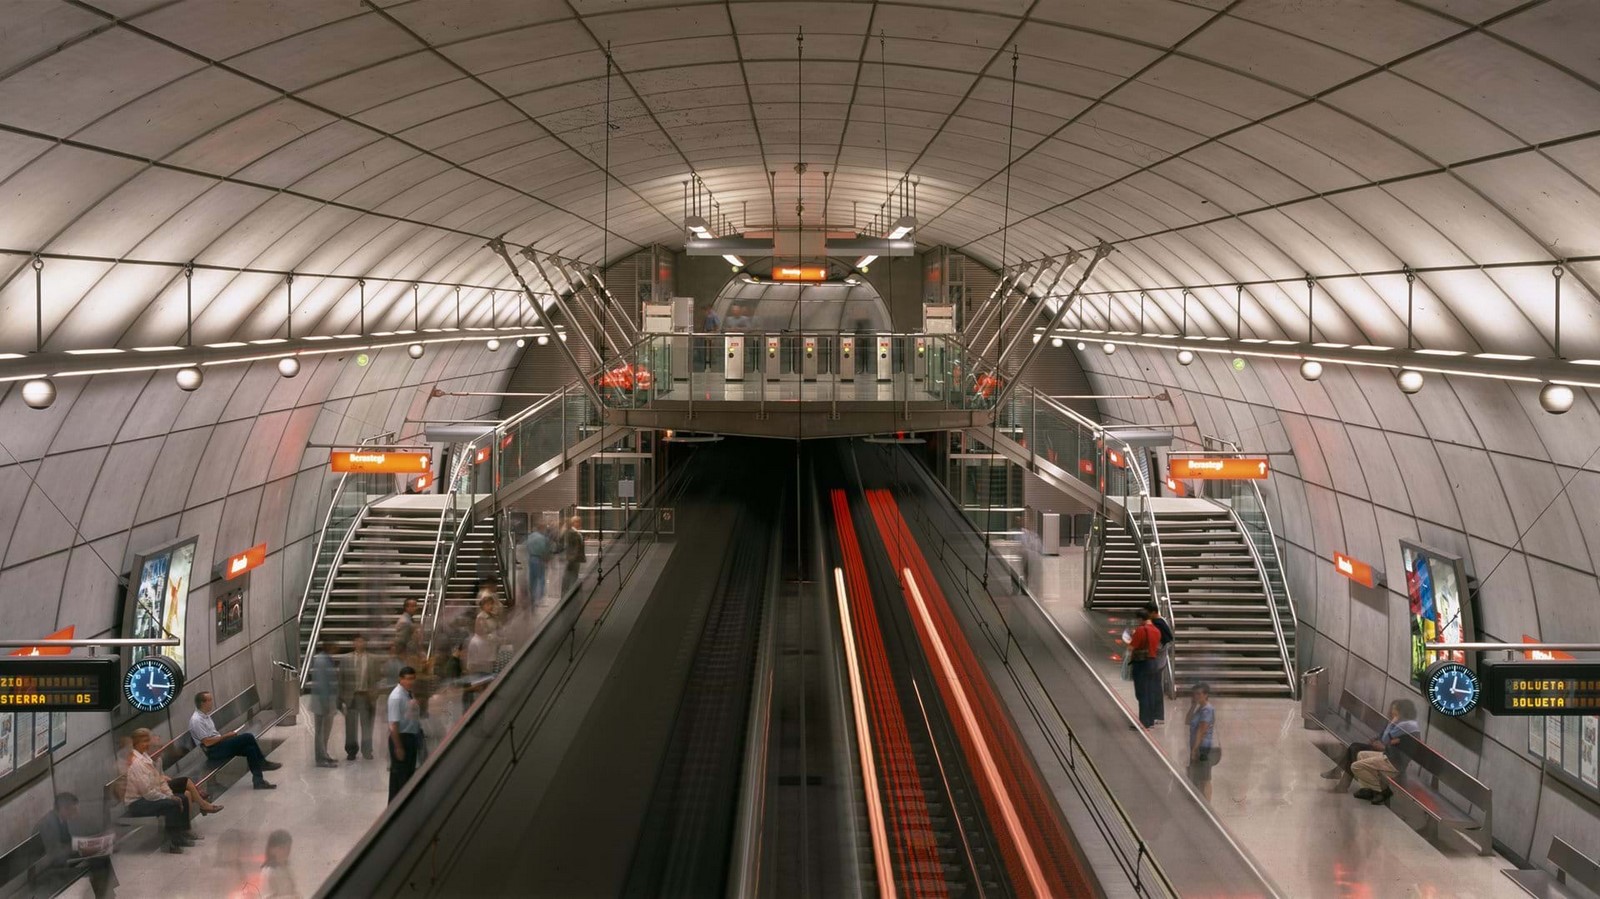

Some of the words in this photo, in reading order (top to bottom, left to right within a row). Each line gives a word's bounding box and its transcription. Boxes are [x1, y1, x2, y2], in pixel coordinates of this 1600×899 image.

[1512, 681, 1564, 690] BOLUETA
[0, 694, 46, 704] STERRA
[76, 694, 91, 703] 05
[1512, 697, 1565, 707] BOLUETA
